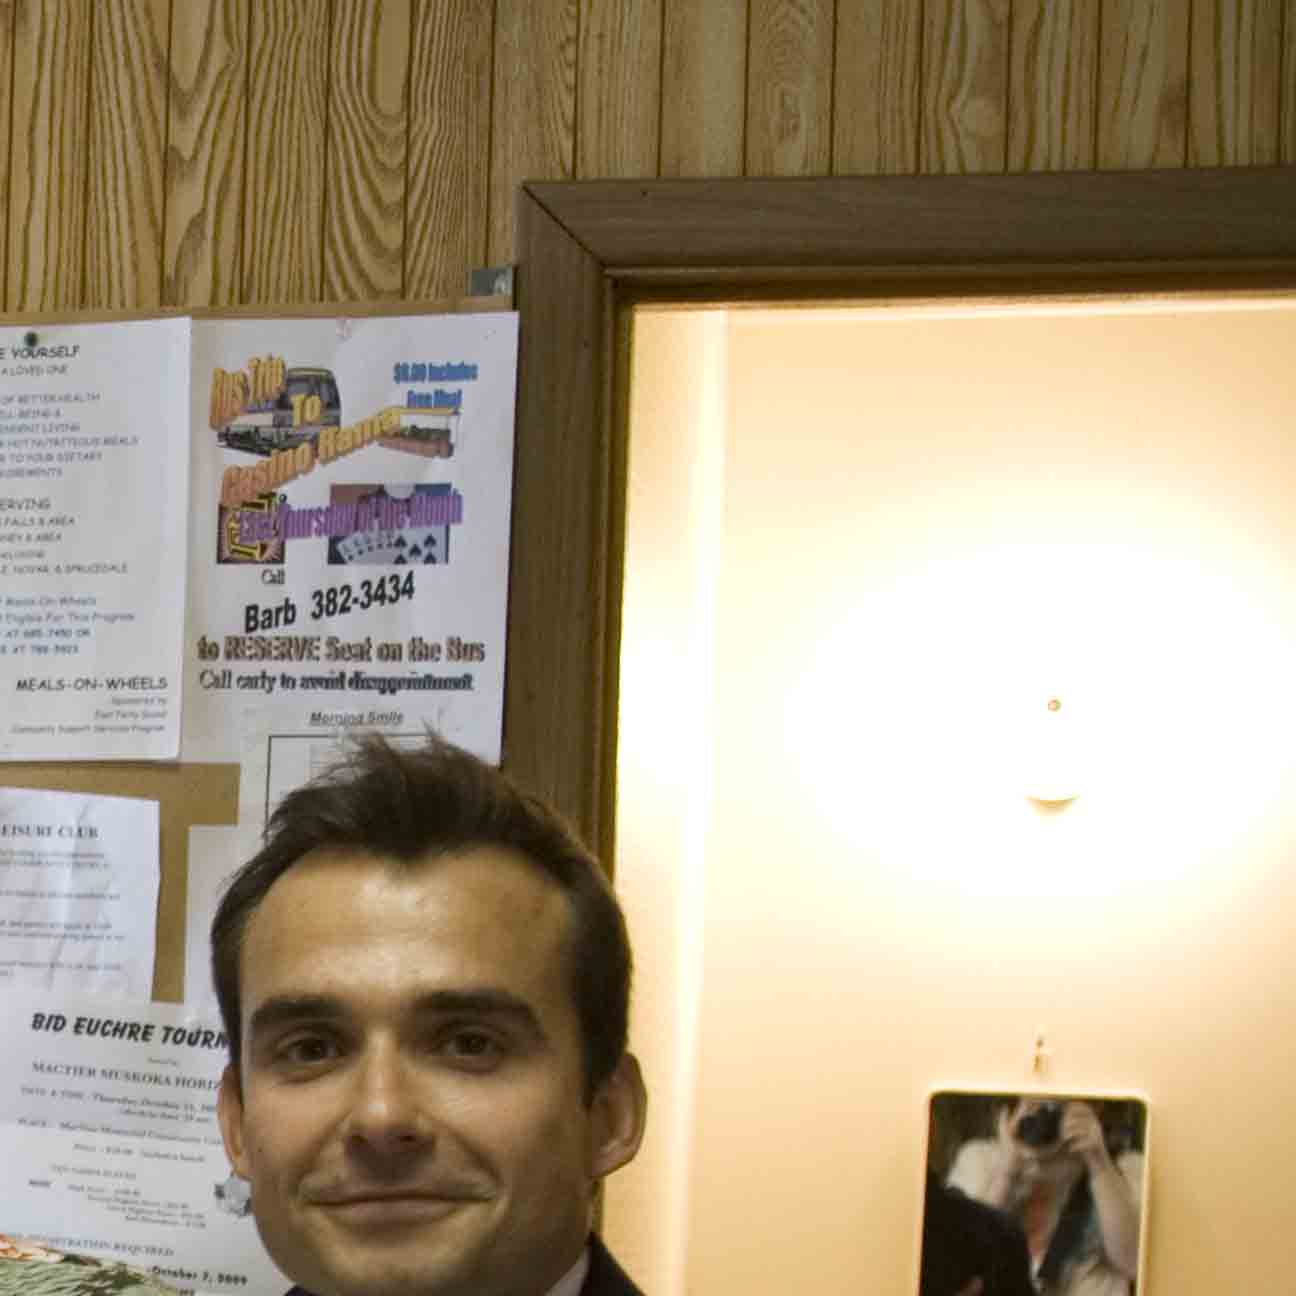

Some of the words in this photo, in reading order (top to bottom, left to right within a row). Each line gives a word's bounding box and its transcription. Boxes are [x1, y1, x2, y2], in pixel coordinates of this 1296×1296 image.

[11, 343, 81, 360] YOURSELF
[10, 364, 44, 377] LOVED
[221, 441, 314, 508] Casino
[317, 407, 401, 465] Rama
[261, 567, 286, 586] Call
[244, 596, 296, 634] Barb
[310, 569, 416, 620] 382-3434
[197, 634, 220, 662] to
[223, 634, 321, 662] RESERVE
[325, 636, 372, 662] Seat
[377, 643, 403, 662] on
[407, 636, 441, 662] the
[445, 635, 486, 662] Bus
[199, 669, 232, 690] Call
[236, 672, 277, 694] early
[280, 671, 296, 690] to
[299, 670, 346, 690] avoid
[57, 824, 99, 839] CLUB
[32, 1012, 67, 1032] BID
[73, 1016, 155, 1043] EUCHRE
[151, 1265, 198, 1281] October
